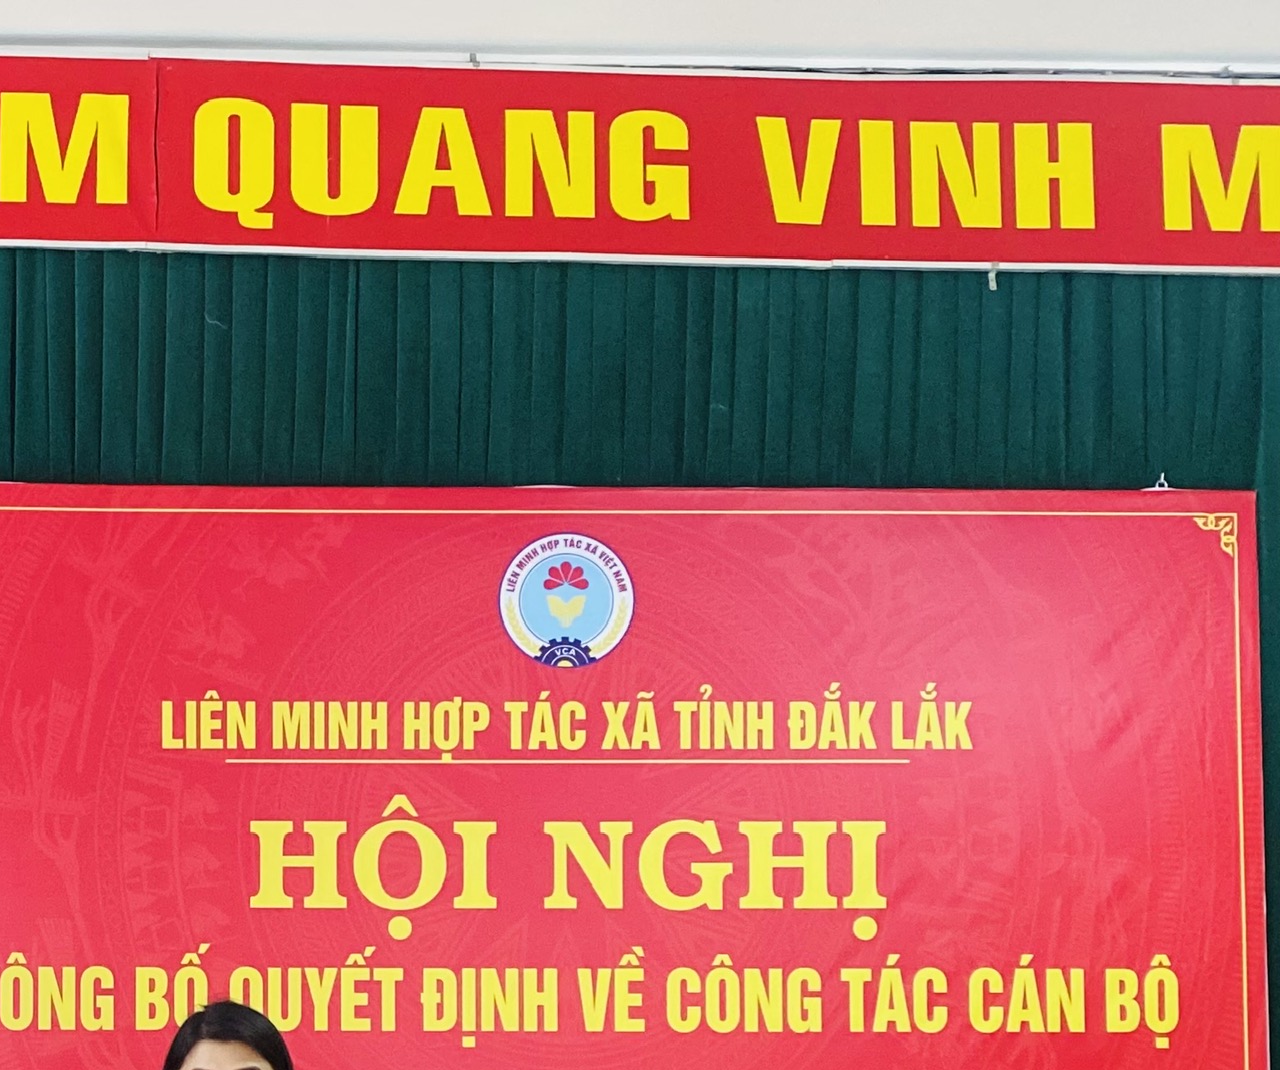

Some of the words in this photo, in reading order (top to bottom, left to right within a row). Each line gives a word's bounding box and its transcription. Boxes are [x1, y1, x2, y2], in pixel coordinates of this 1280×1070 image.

[193, 97, 690, 230] QUANG
[756, 116, 1096, 230] VINH
[516, 548, 539, 571] MINH
[540, 539, 560, 552] HỢP
[563, 537, 582, 549] TÁC
[613, 570, 627, 593] NAM
[555, 648, 576, 656] VCA
[161, 690, 257, 750] LIÊN
[272, 700, 388, 750] MINH
[403, 696, 490, 761] HỢP
[504, 691, 586, 750] TÁC
[601, 692, 660, 750] XÃ
[674, 684, 774, 750] TỈNH
[787, 684, 876, 750] ĐẮK
[891, 684, 972, 750] LẮK
[249, 794, 498, 941] HỘI
[543, 819, 887, 941] NGHỊ
[135, 943, 210, 1031] BỐ
[420, 967, 559, 1049] ĐỊNH
[577, 946, 646, 1033] VỀ
[665, 953, 823, 1034] CÔNG
[840, 954, 949, 1034] TÁC
[968, 954, 1086, 1034] CÁN
[1105, 953, 1180, 1049] BỘ
